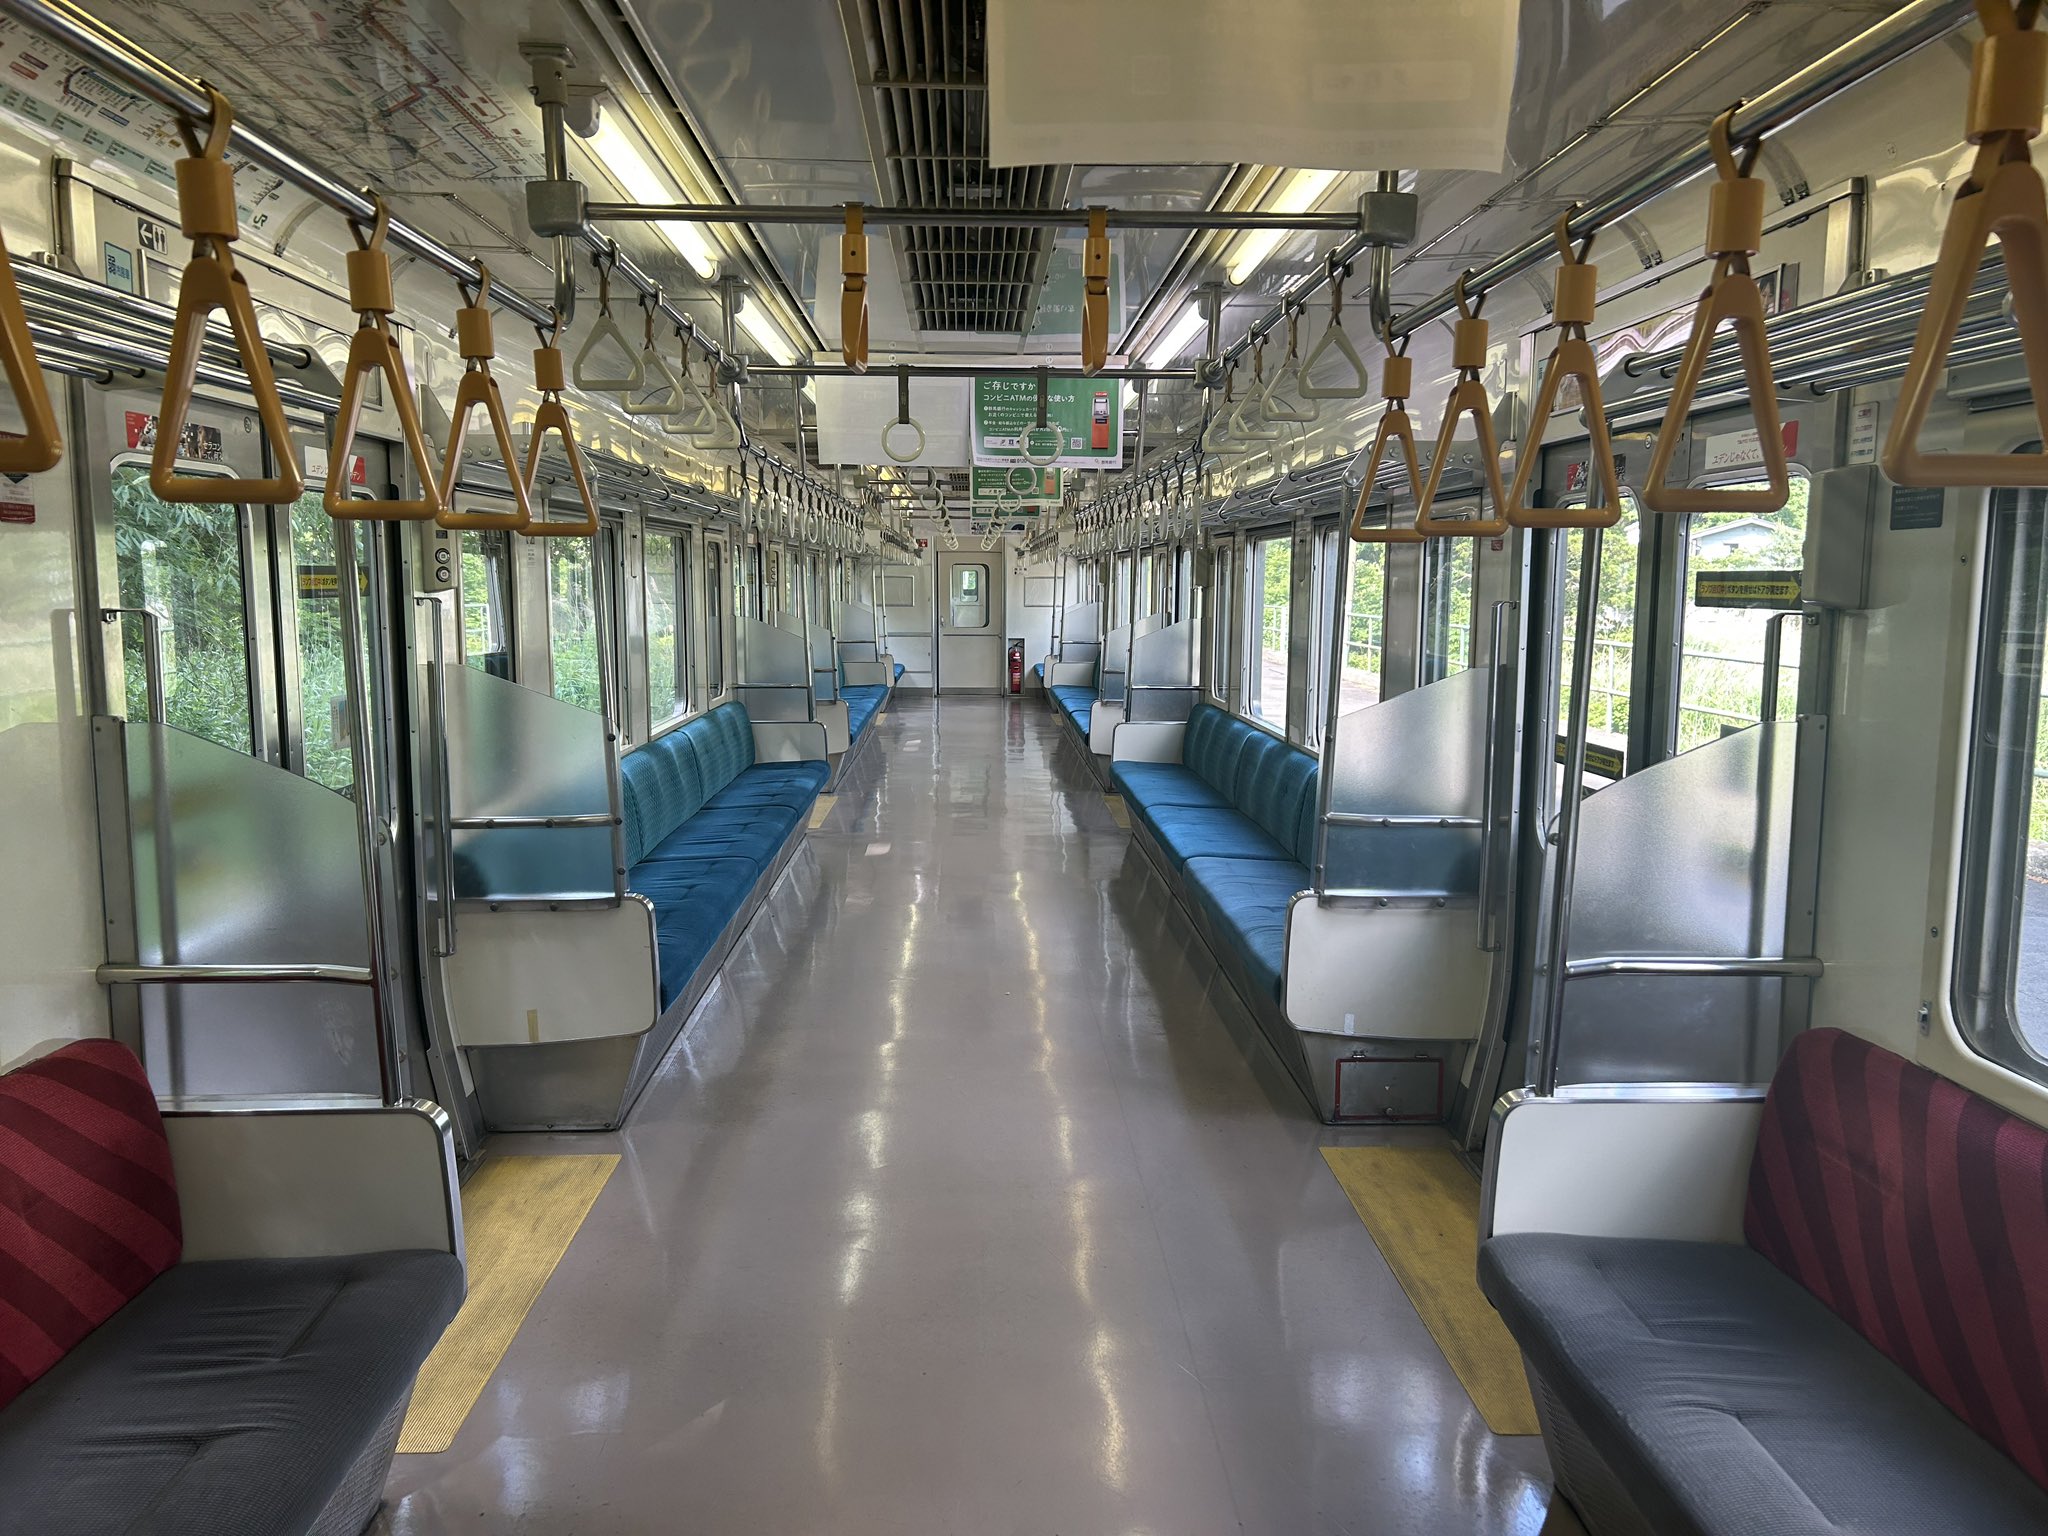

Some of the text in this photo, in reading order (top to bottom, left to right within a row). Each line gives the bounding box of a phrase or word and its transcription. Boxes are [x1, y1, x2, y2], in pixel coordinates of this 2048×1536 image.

[983, 380, 1036, 391] ご存じですか
[202, 440, 223, 452] セラコン
